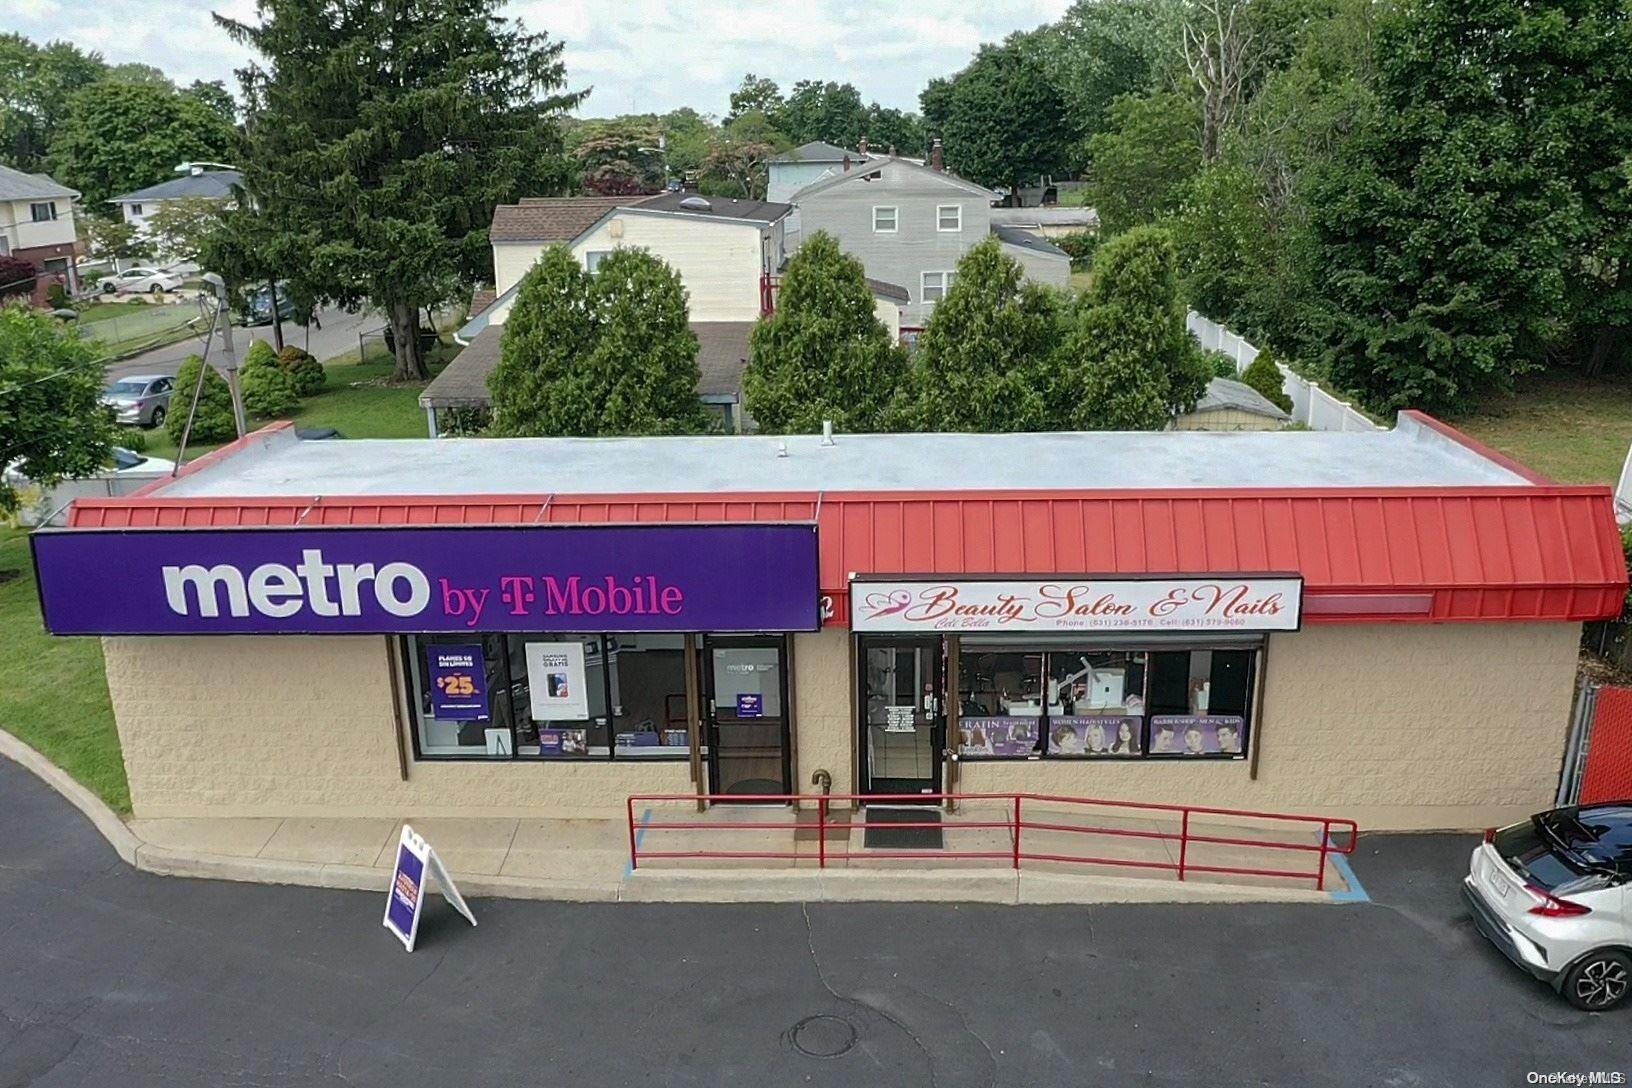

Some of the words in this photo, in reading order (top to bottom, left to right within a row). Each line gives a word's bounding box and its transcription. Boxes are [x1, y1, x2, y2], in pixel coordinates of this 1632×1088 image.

[162, 549, 431, 618] metro
[439, 578, 490, 626] by
[542, 576, 683, 615] Mobile
[904, 585, 1037, 624] Beauty
[1034, 584, 1136, 618] Salon
[1149, 588, 1188, 617] &
[1191, 584, 1286, 618] Nails
[436, 674, 474, 695] $25
